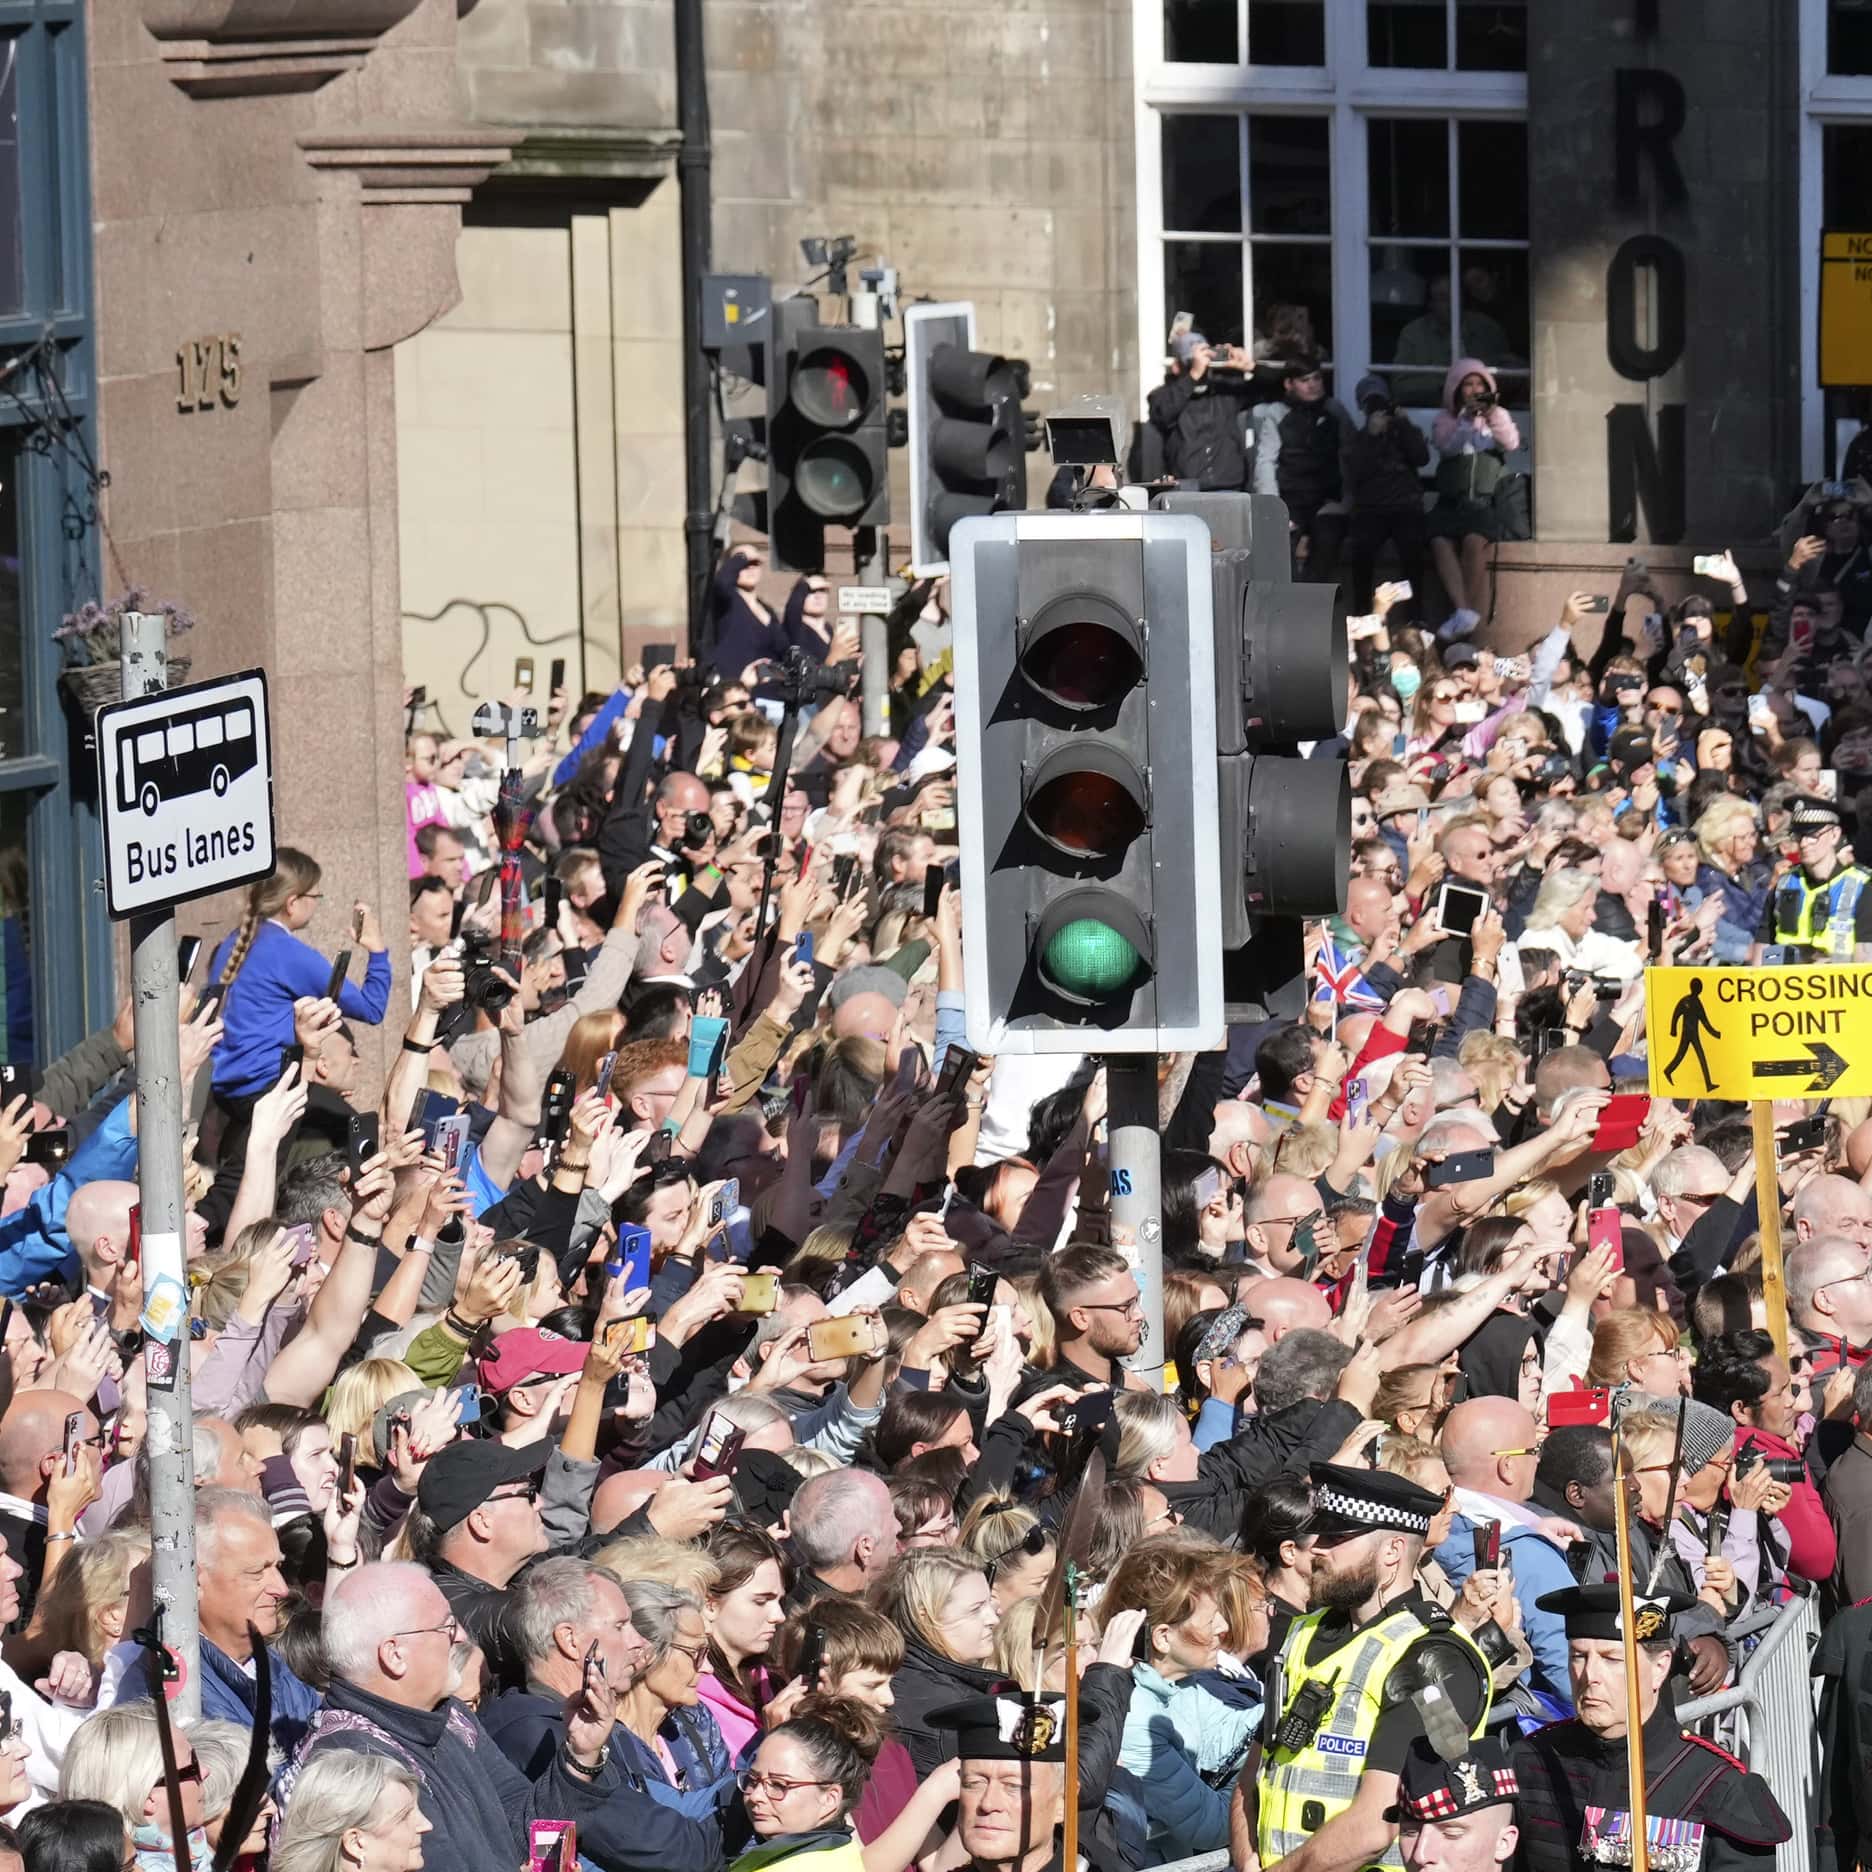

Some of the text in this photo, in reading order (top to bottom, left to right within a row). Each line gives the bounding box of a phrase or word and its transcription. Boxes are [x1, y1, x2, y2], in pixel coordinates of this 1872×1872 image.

[176, 335, 241, 413] 175
[127, 822, 255, 884] Bus lanes
[1751, 1009, 1847, 1038] POINT
[1319, 1736, 1365, 1755] POLICE
